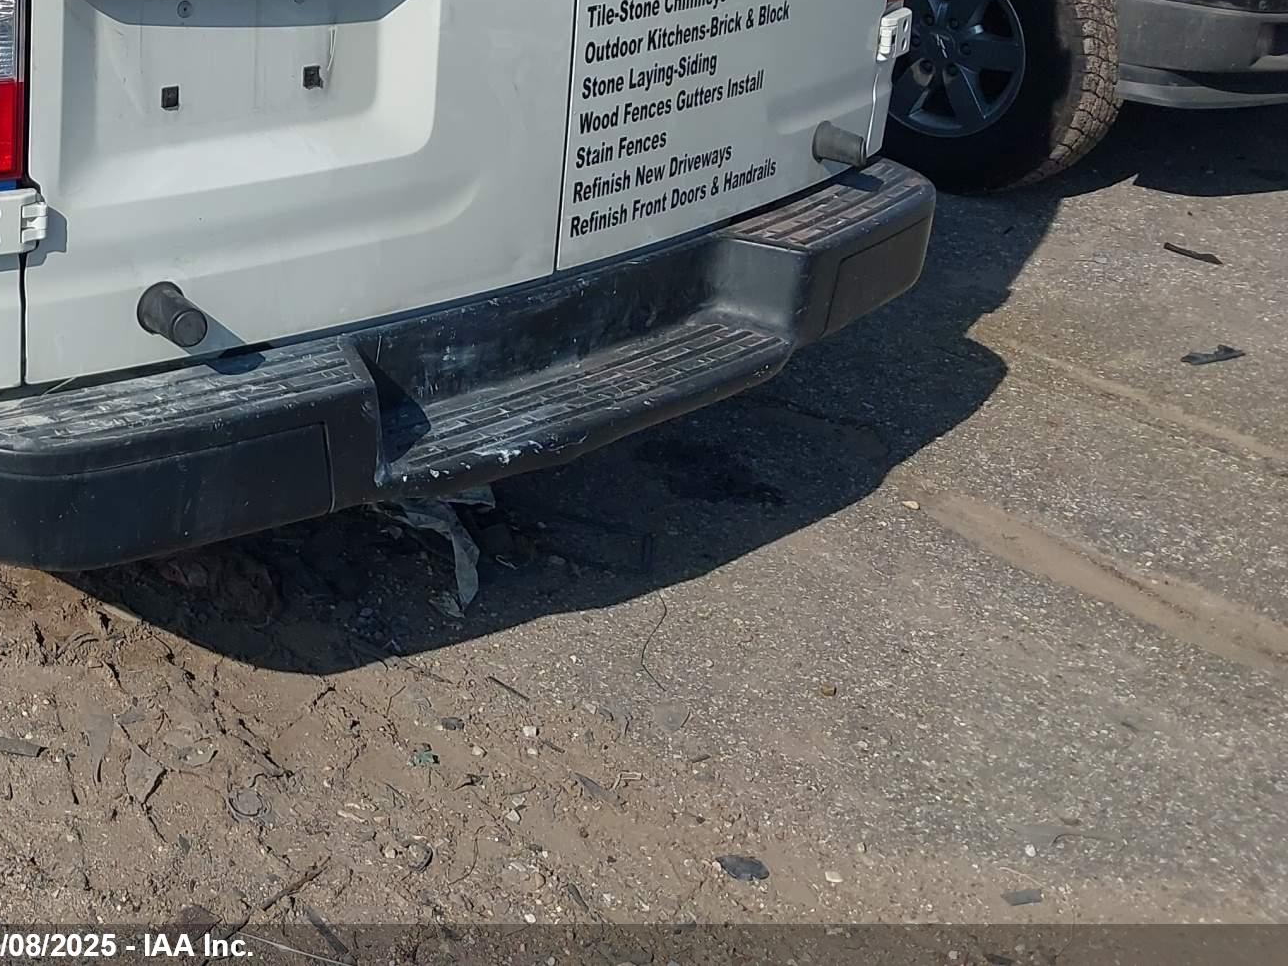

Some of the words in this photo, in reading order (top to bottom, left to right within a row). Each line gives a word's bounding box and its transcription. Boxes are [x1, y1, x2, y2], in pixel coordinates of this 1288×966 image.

[585, 37, 643, 64] Outdoor
[647, 10, 742, 52] Kitchens-Brick
[746, 8, 754, 29] &
[758, 0, 790, 26] Block
[579, 106, 619, 135] Wood
[623, 98, 672, 125] Fences
[676, 86, 723, 111] Gutters
[727, 69, 764, 99] Install
[582, 75, 624, 100] Stone
[629, 54, 718, 91] Laying-Siding
[572, 170, 631, 204] Refinish
[635, 163, 665, 187] New
[669, 145, 732, 178] Driveways
[575, 142, 613, 169] Stain
[618, 132, 667, 159] Fences
[570, 204, 628, 238] Refinish
[632, 192, 667, 221] Front
[670, 182, 707, 209] Doors
[710, 176, 719, 196] &
[723, 158, 777, 192] Handrails
